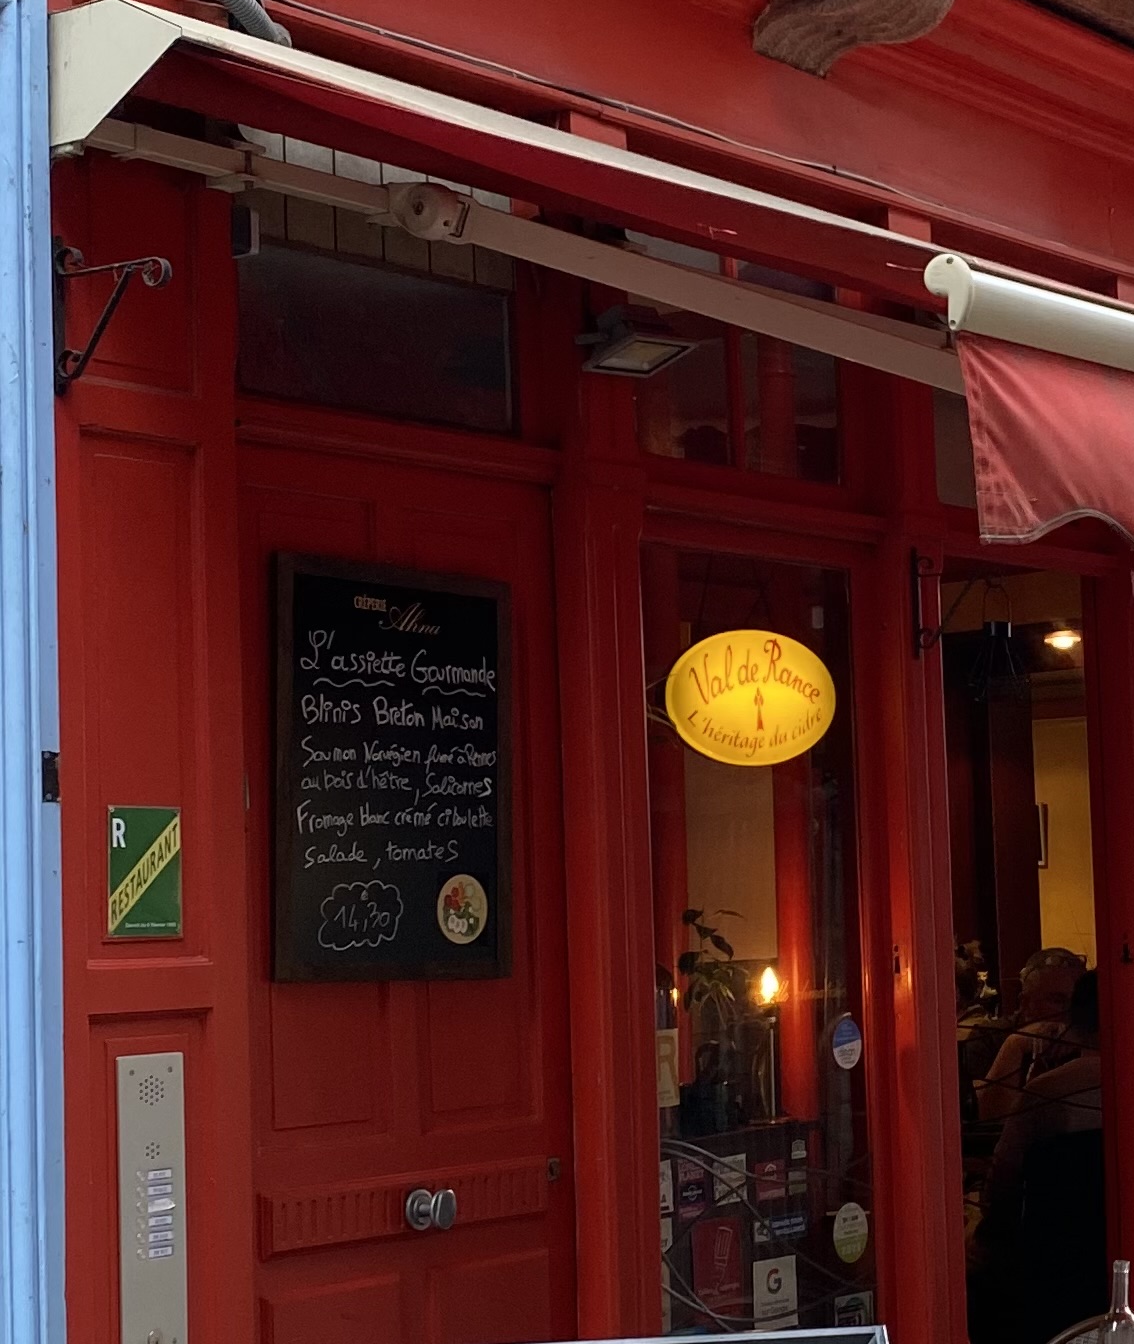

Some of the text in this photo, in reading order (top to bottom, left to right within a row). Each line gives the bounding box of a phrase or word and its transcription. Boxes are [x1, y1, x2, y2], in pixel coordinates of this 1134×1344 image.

[411, 649, 496, 692] Gourmande
[688, 638, 821, 705] Val de Rance
[301, 694, 483, 730] Blinis Breton Maison
[769, 724, 788, 747] du
[112, 818, 126, 848] R
[297, 799, 354, 837] Fromage
[359, 802, 390, 827] blanc
[385, 839, 459, 862] tomates
[111, 823, 178, 924] RESTAURANT
